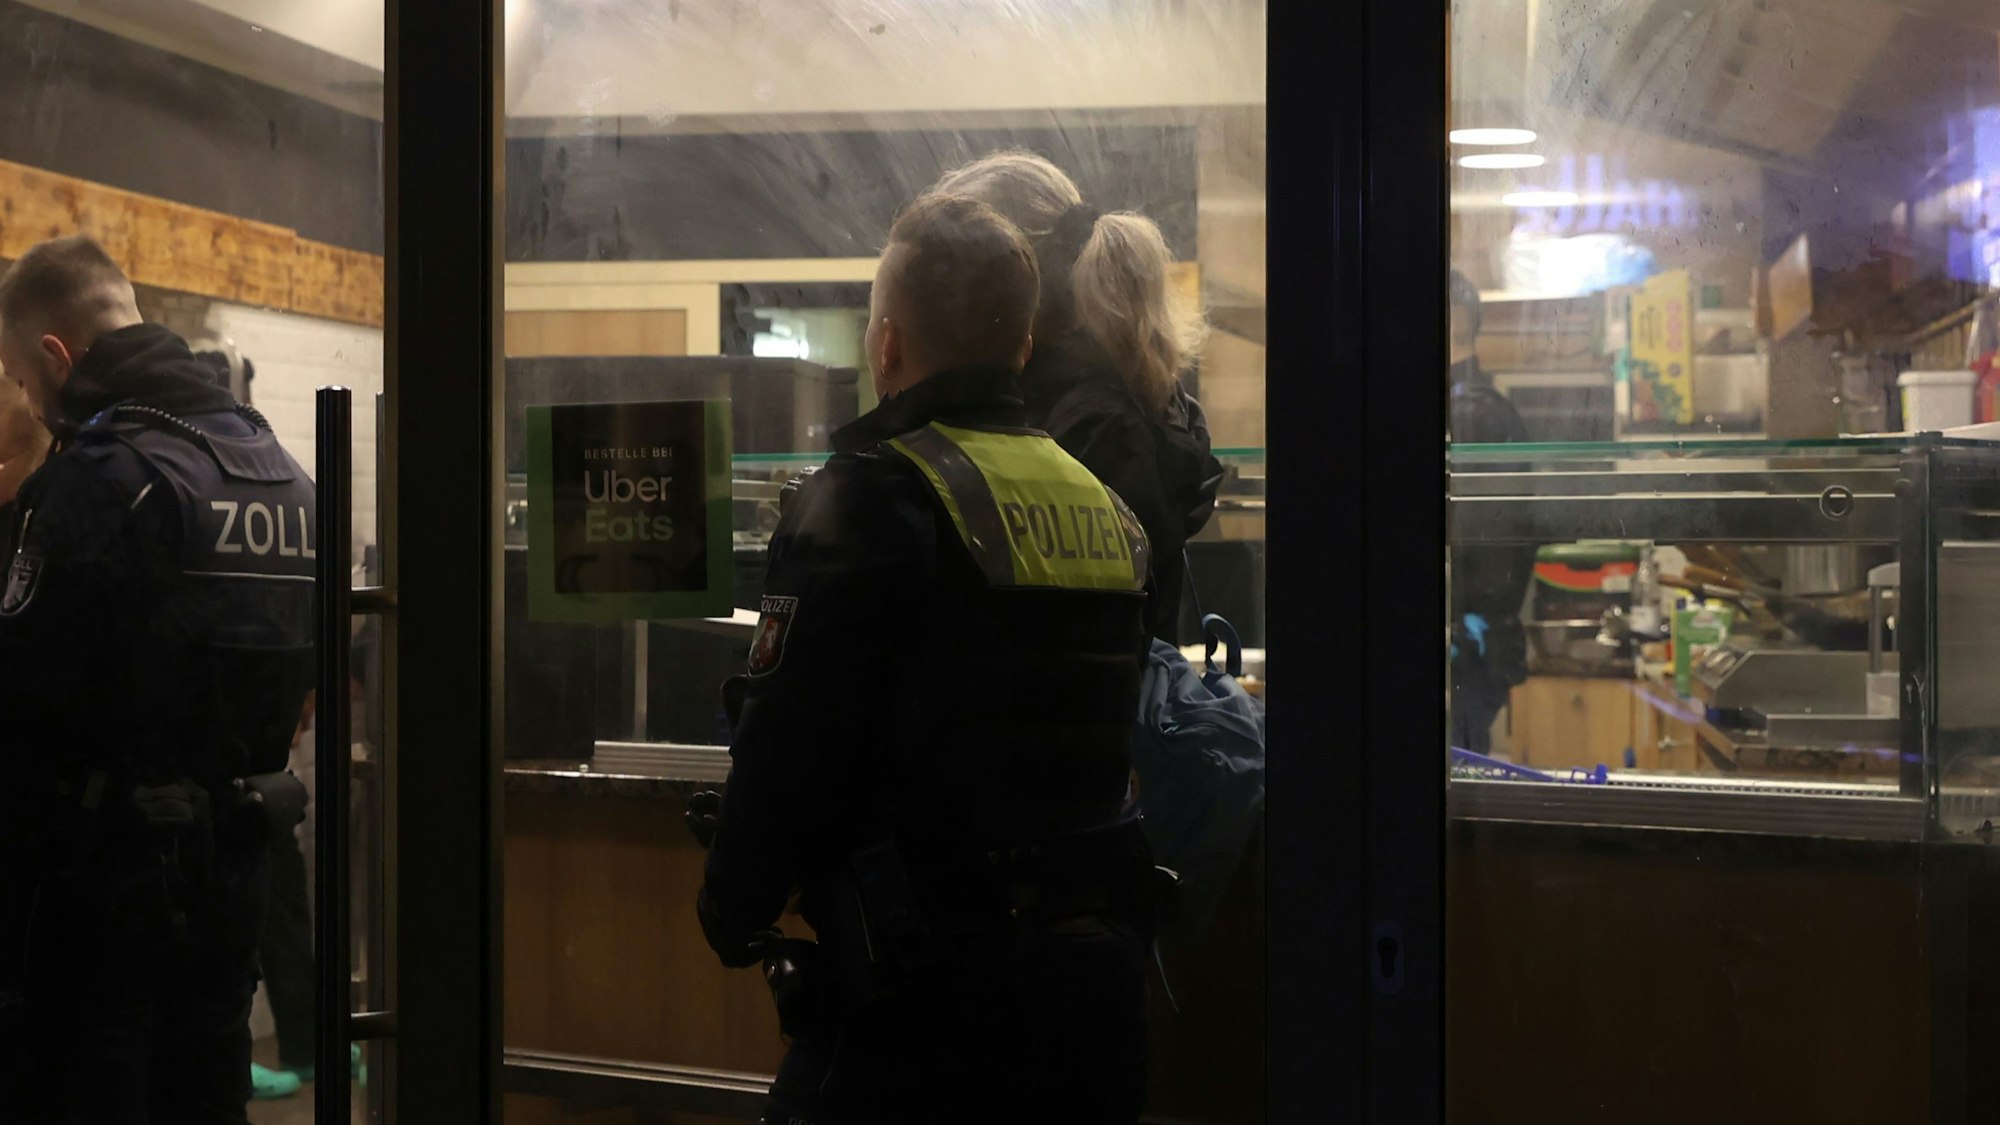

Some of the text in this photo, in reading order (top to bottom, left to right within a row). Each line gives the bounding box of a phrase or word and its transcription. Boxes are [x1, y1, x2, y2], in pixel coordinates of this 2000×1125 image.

[584, 447, 672, 460] BESTELLE BEI
[584, 469, 673, 503] Uber
[210, 500, 317, 559] ZOLL
[585, 508, 675, 543] Eats
[1003, 502, 1127, 560] POLIZEI
[761, 599, 797, 614] OLIZEI
